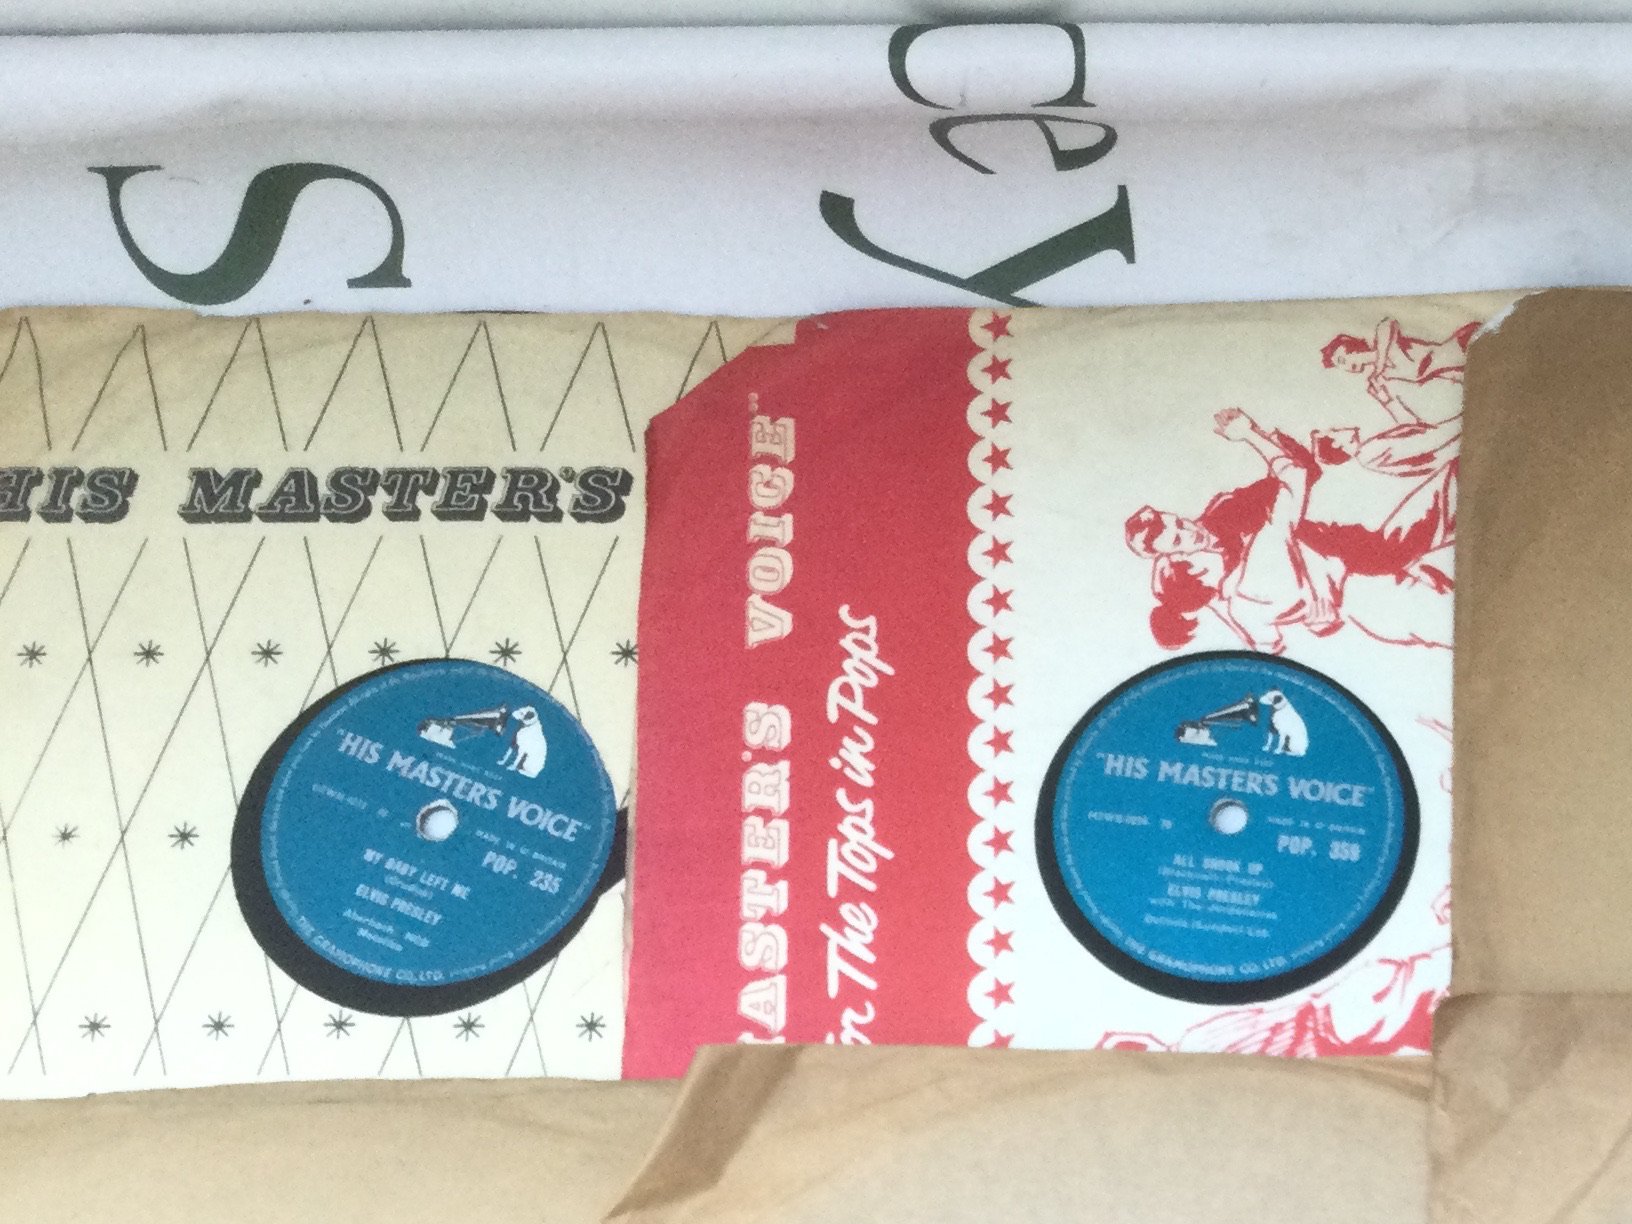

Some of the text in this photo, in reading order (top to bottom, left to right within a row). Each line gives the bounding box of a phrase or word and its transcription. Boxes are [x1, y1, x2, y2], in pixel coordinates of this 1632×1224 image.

[178, 466, 635, 524] MASTER'S
[828, 604, 894, 727] Pops
[828, 727, 877, 791] in
[420, 870, 449, 891] LEFT
[736, 702, 794, 1044] ASTER'S
[828, 790, 894, 897] Tops
[821, 907, 878, 1001] The
